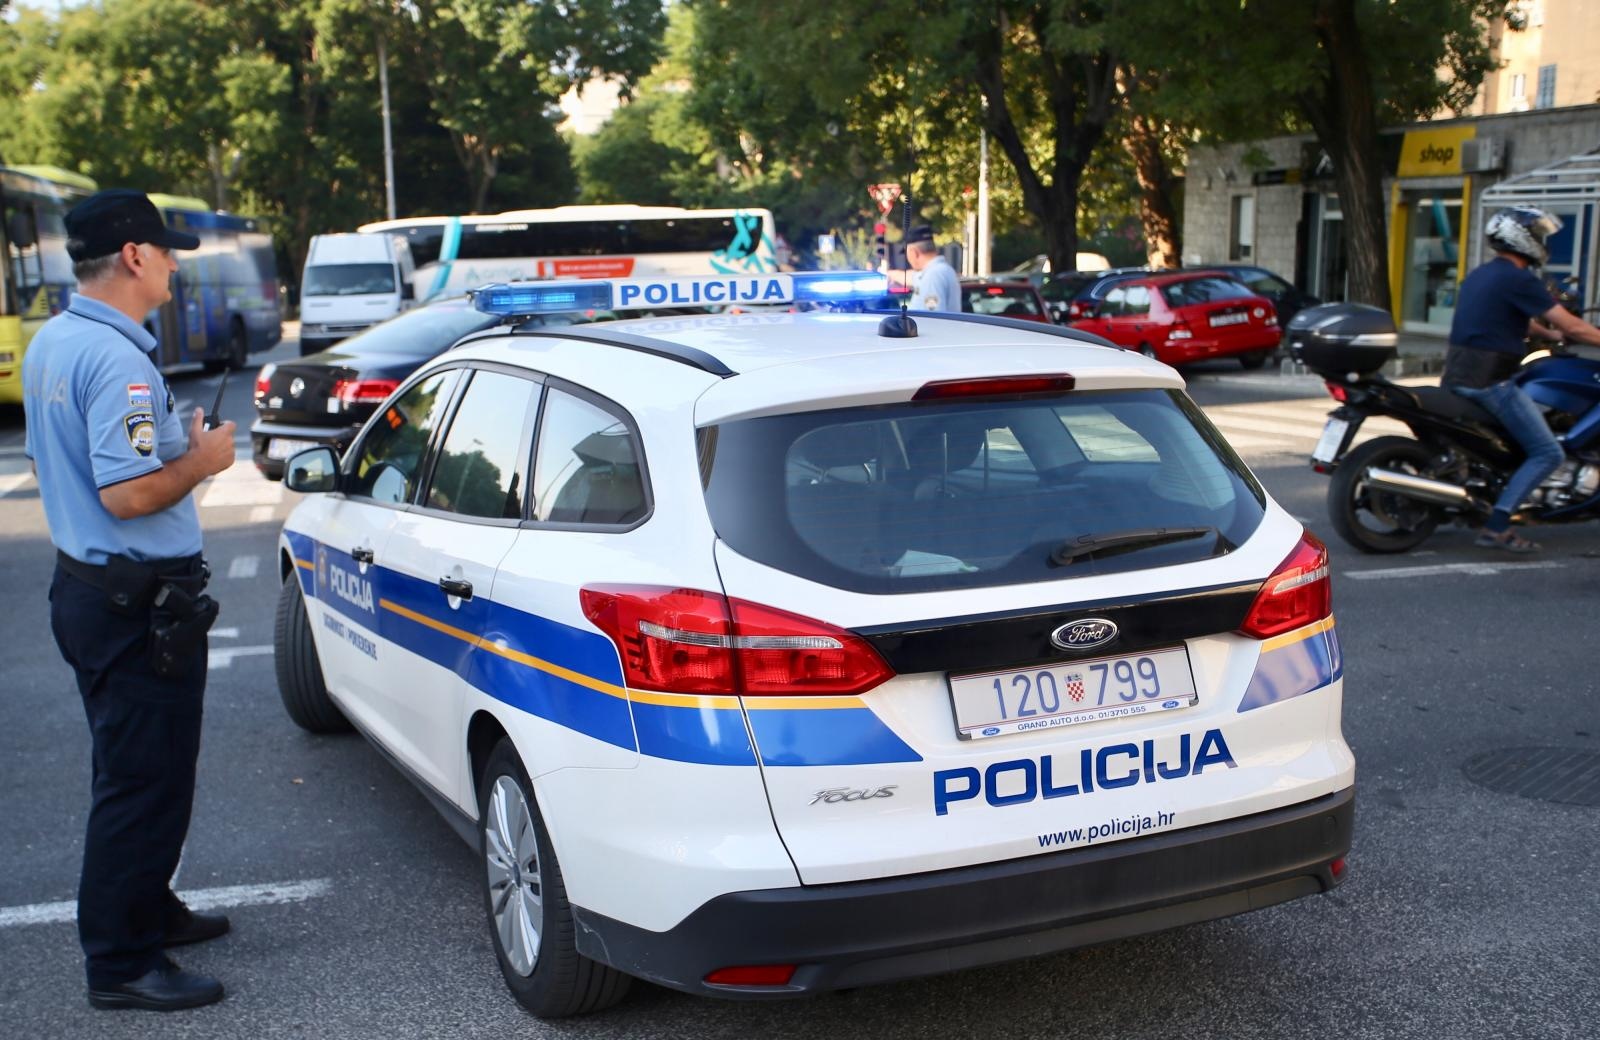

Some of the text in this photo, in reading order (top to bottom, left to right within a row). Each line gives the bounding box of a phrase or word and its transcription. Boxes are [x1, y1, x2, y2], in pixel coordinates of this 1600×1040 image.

[1419, 142, 1454, 166] shop
[620, 279, 785, 306] POLICIJA
[330, 563, 376, 615] POLICIJA
[1068, 623, 1105, 643] Ford
[993, 657, 1161, 720] 120 799
[1017, 705, 1147, 731] GRAND AUTO d.o.o. 01/3710 555
[933, 728, 1238, 816] POLICIJA
[1038, 811, 1176, 848] www.policija.hr
